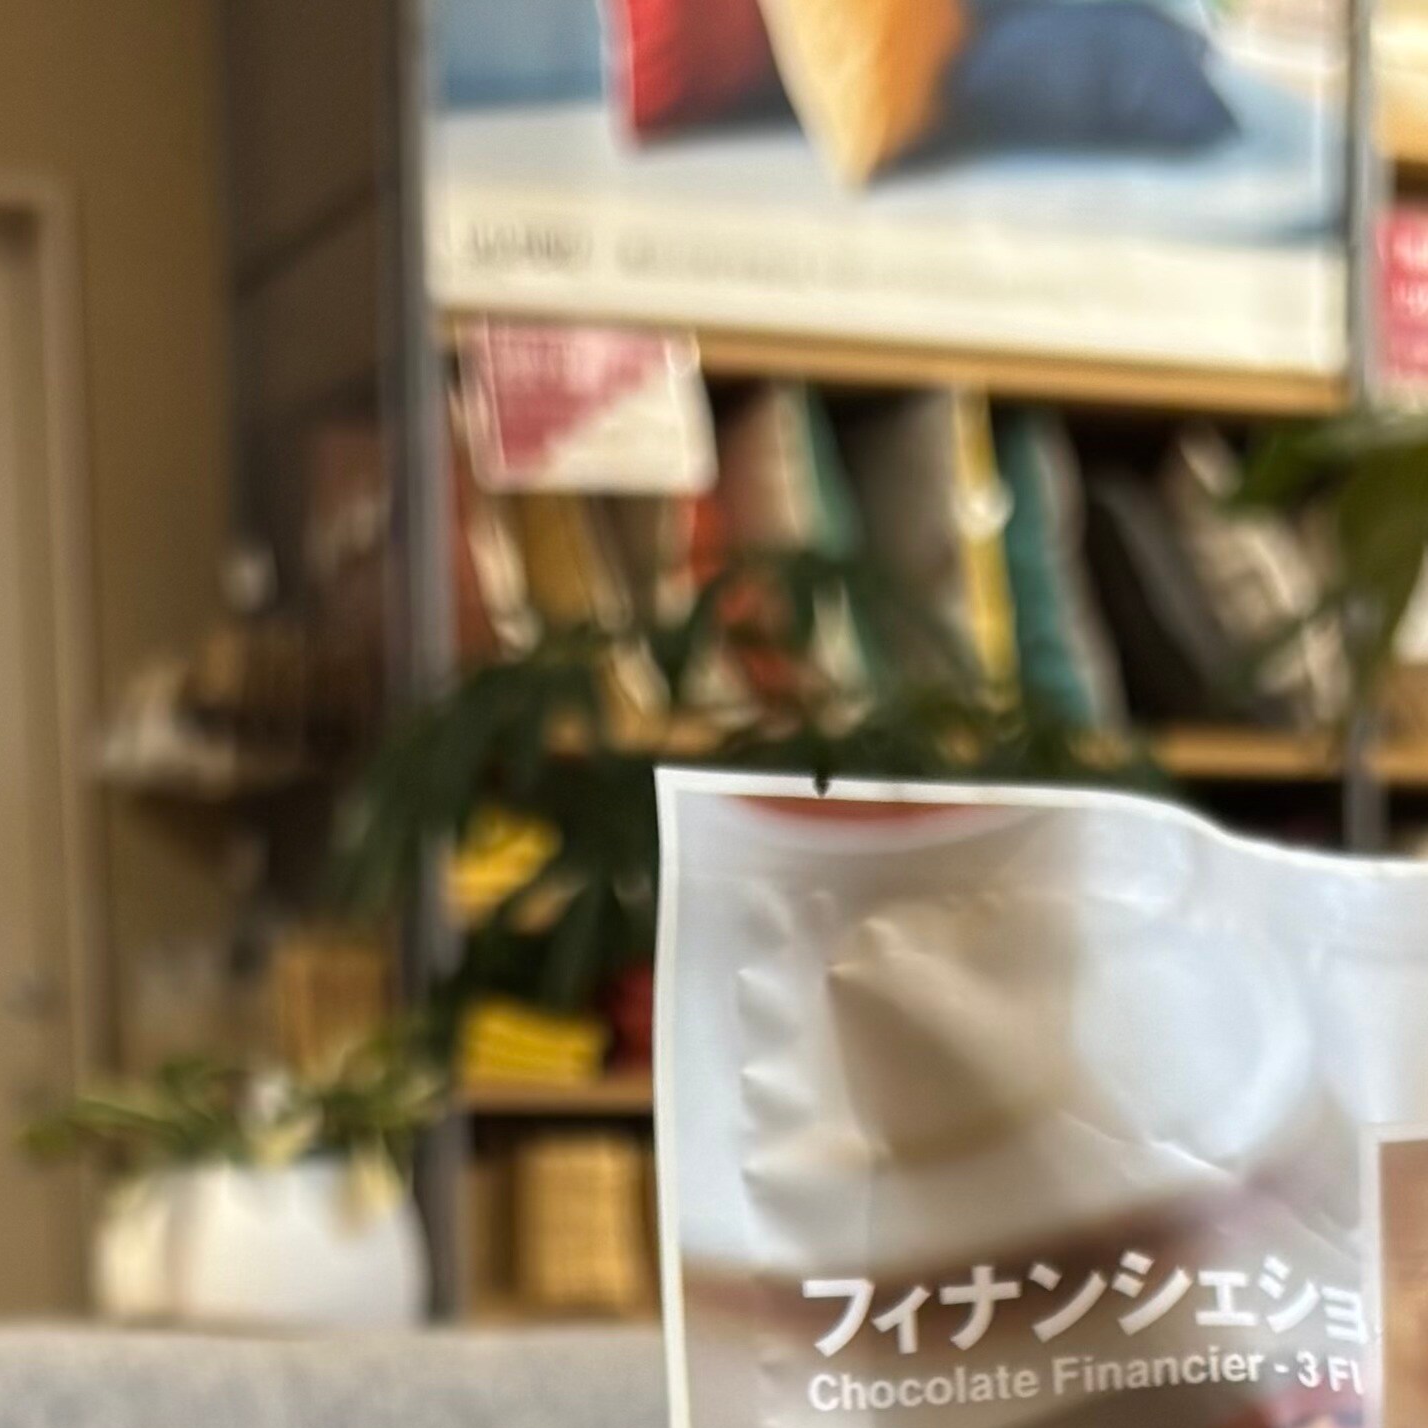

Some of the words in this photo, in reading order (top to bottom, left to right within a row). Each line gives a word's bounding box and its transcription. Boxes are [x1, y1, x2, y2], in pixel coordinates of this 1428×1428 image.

[809, 1366, 1039, 1411] Chocolate
[1053, 1345, 1263, 1395] Financier
[1298, 1351, 1318, 1387] 3
